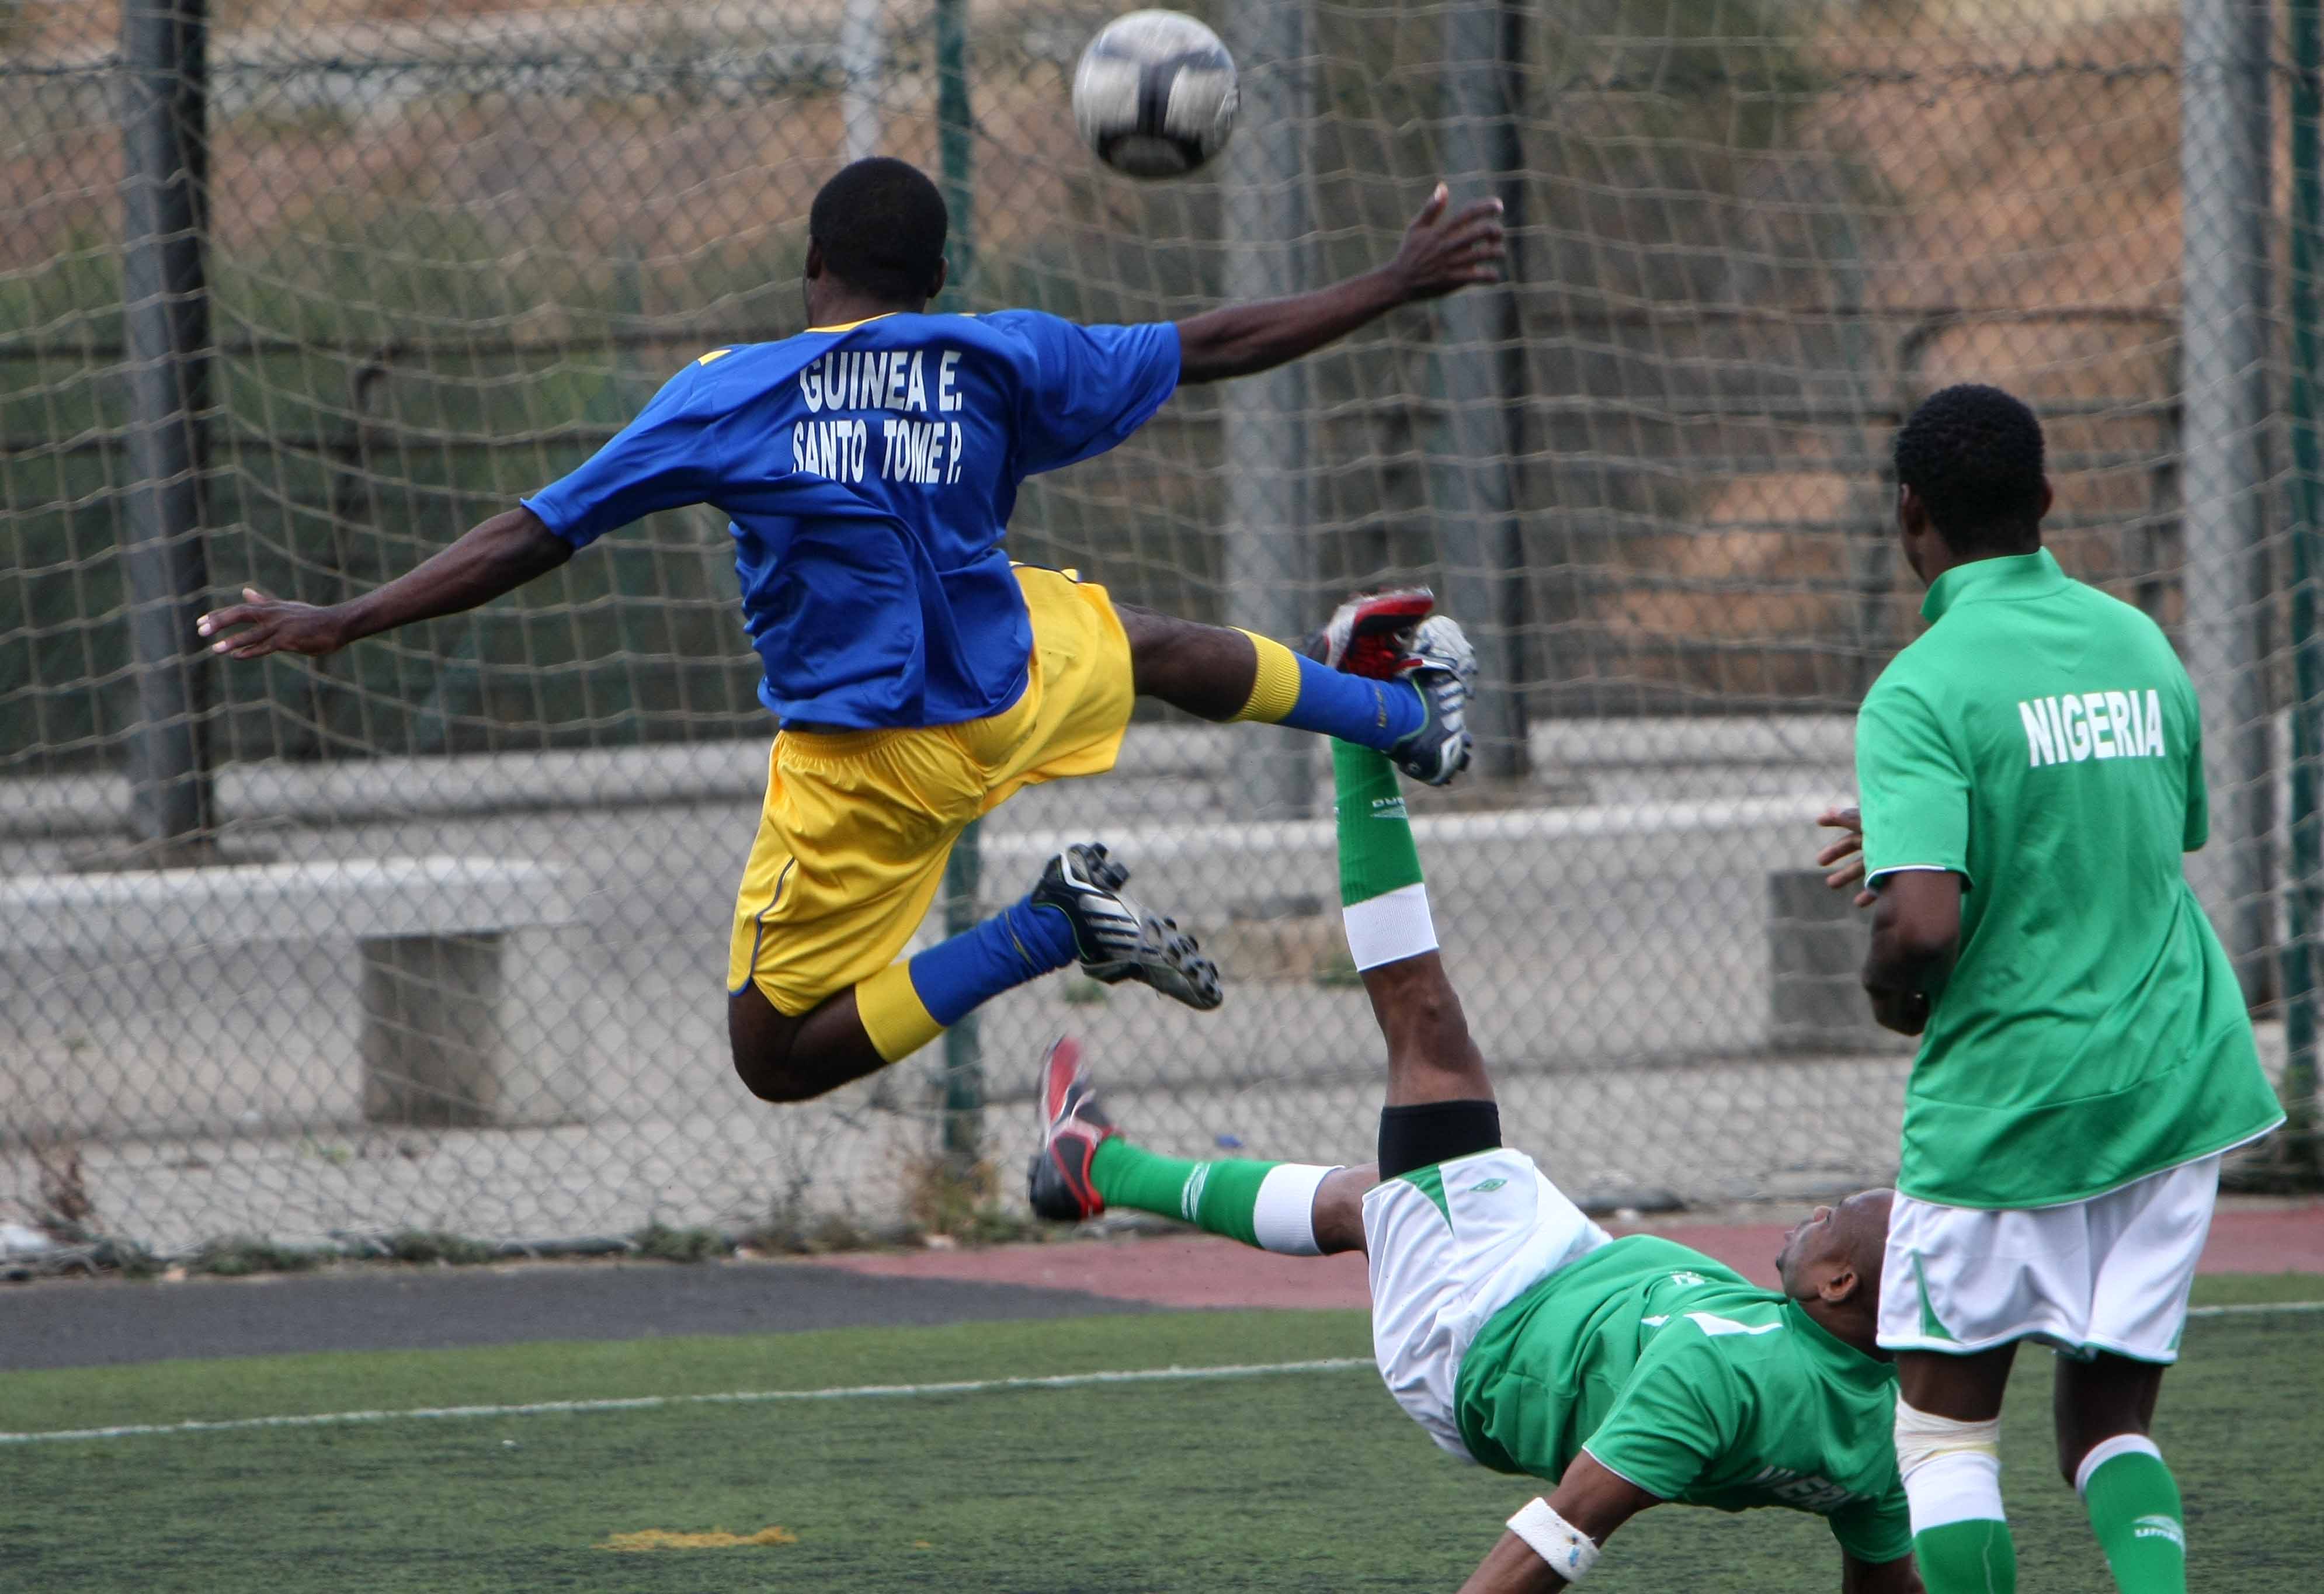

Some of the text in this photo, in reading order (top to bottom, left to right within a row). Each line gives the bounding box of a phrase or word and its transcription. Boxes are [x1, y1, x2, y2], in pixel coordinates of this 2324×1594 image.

[799, 350, 963, 413] GUINEA E.
[793, 418, 867, 484] SANTO
[2018, 689, 2166, 768] NIGERIA
